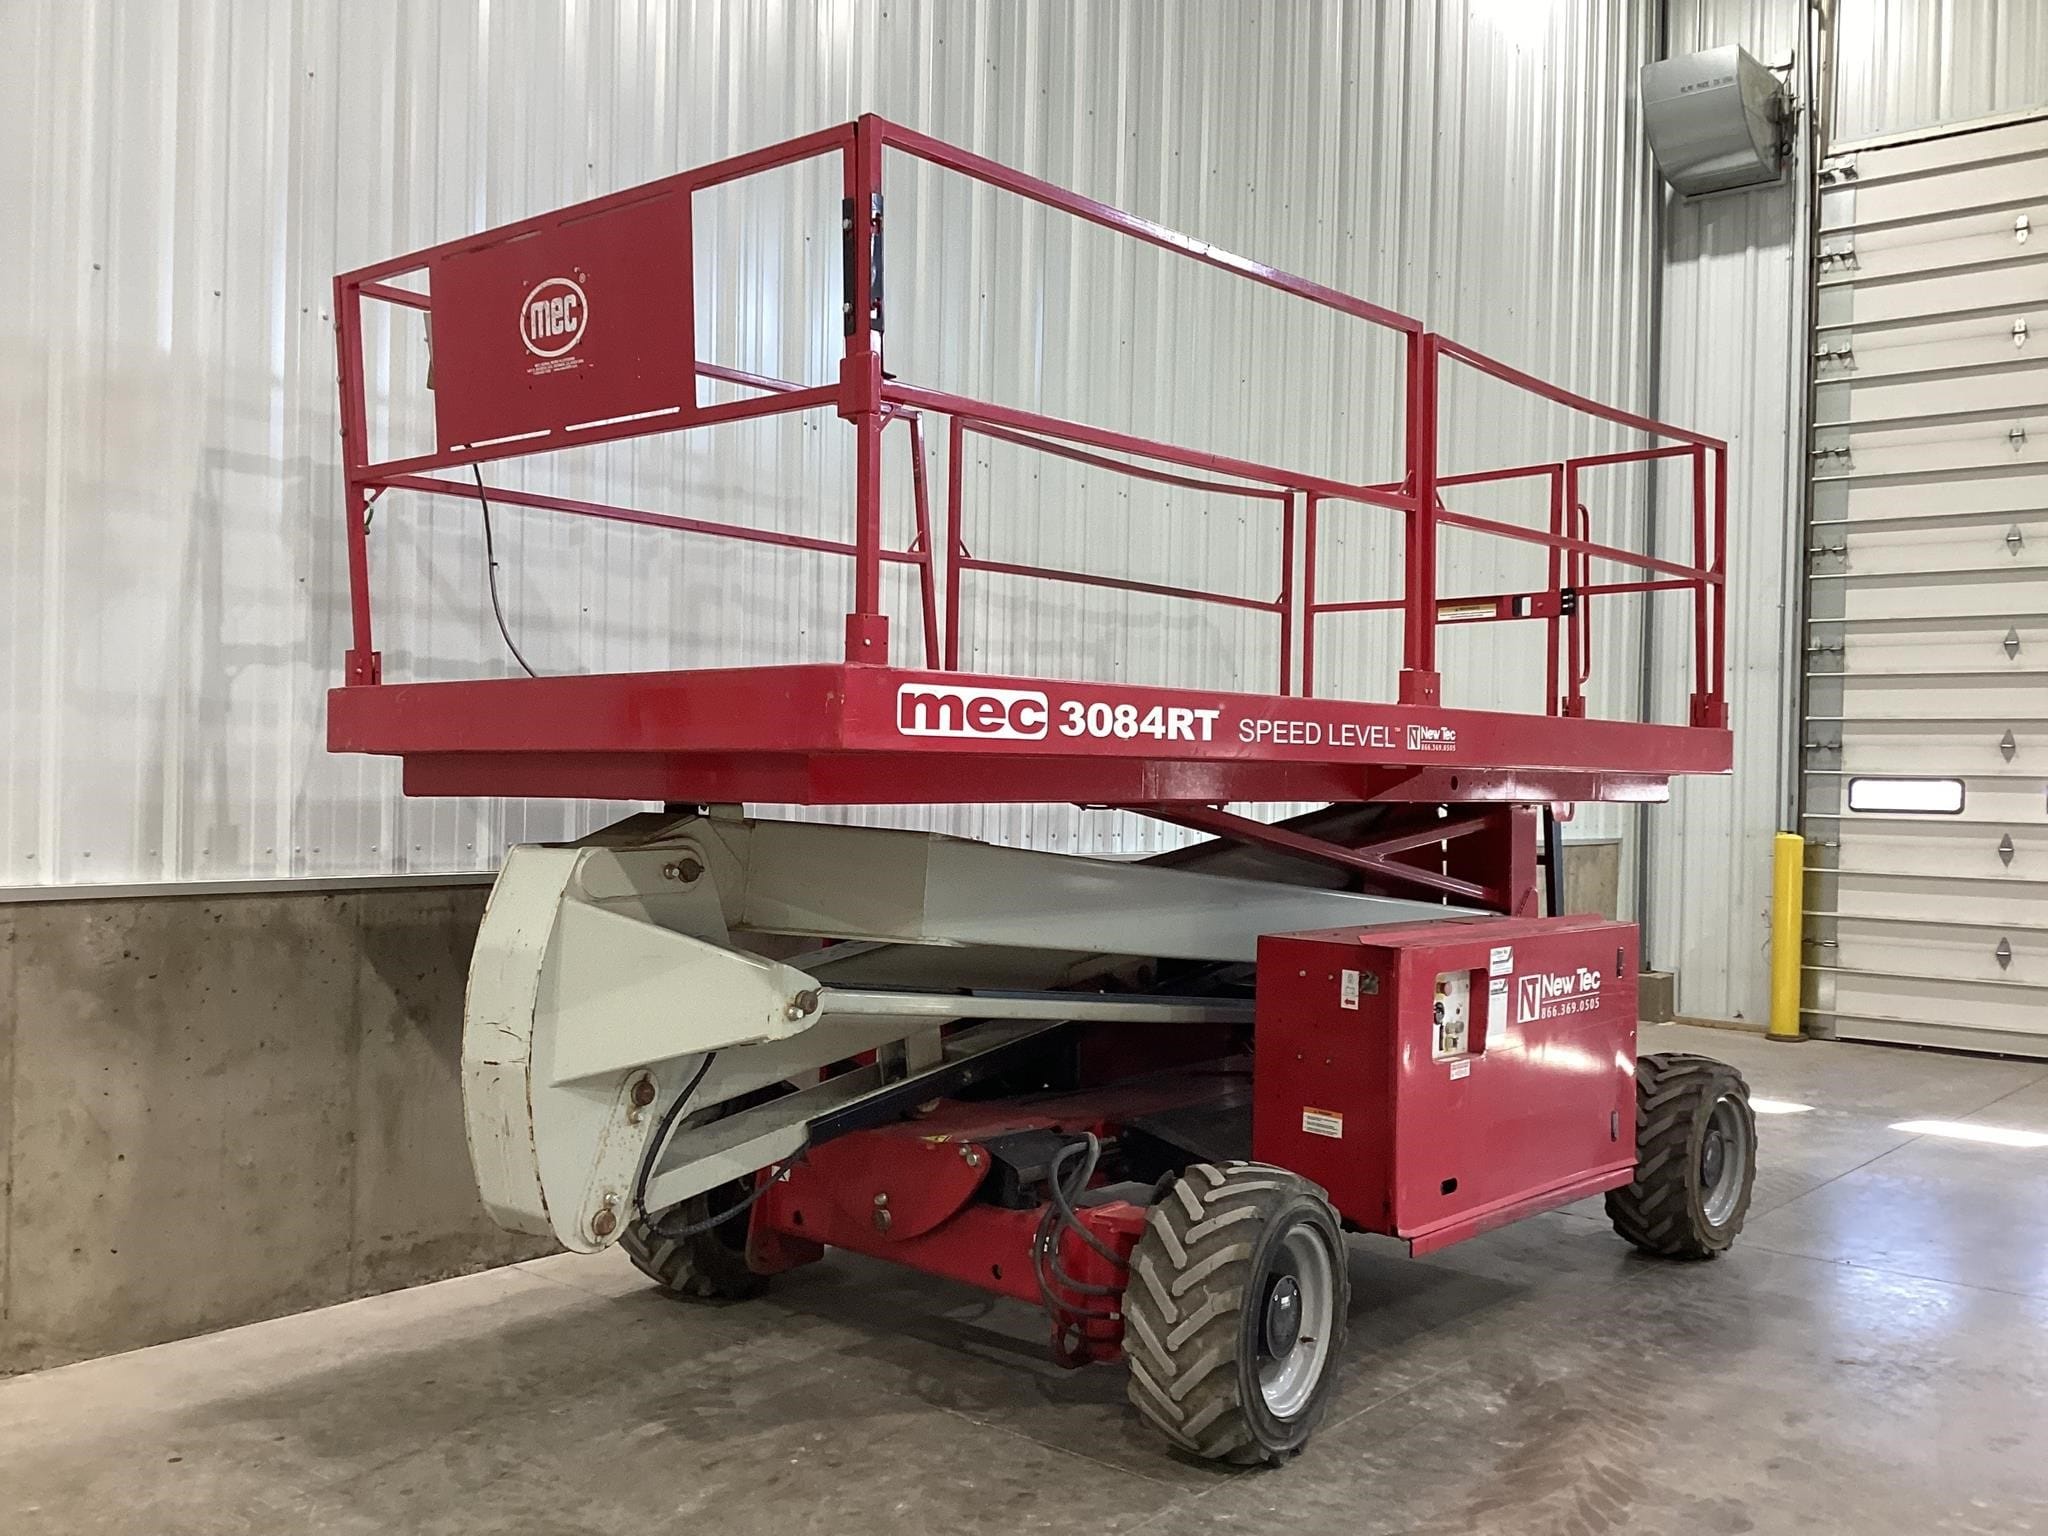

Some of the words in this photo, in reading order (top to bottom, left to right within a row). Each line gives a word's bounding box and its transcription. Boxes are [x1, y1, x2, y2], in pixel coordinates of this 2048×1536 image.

[900, 692, 1046, 733] mec
[1058, 701, 1221, 741] 3084RT
[1238, 718, 1322, 745] SPEED
[1420, 726, 1440, 740] New
[1440, 726, 1457, 741] Tec
[1541, 973, 1575, 998] New
[1576, 967, 1601, 992] Tec
[1541, 997, 1600, 1020] 866.369.0505
